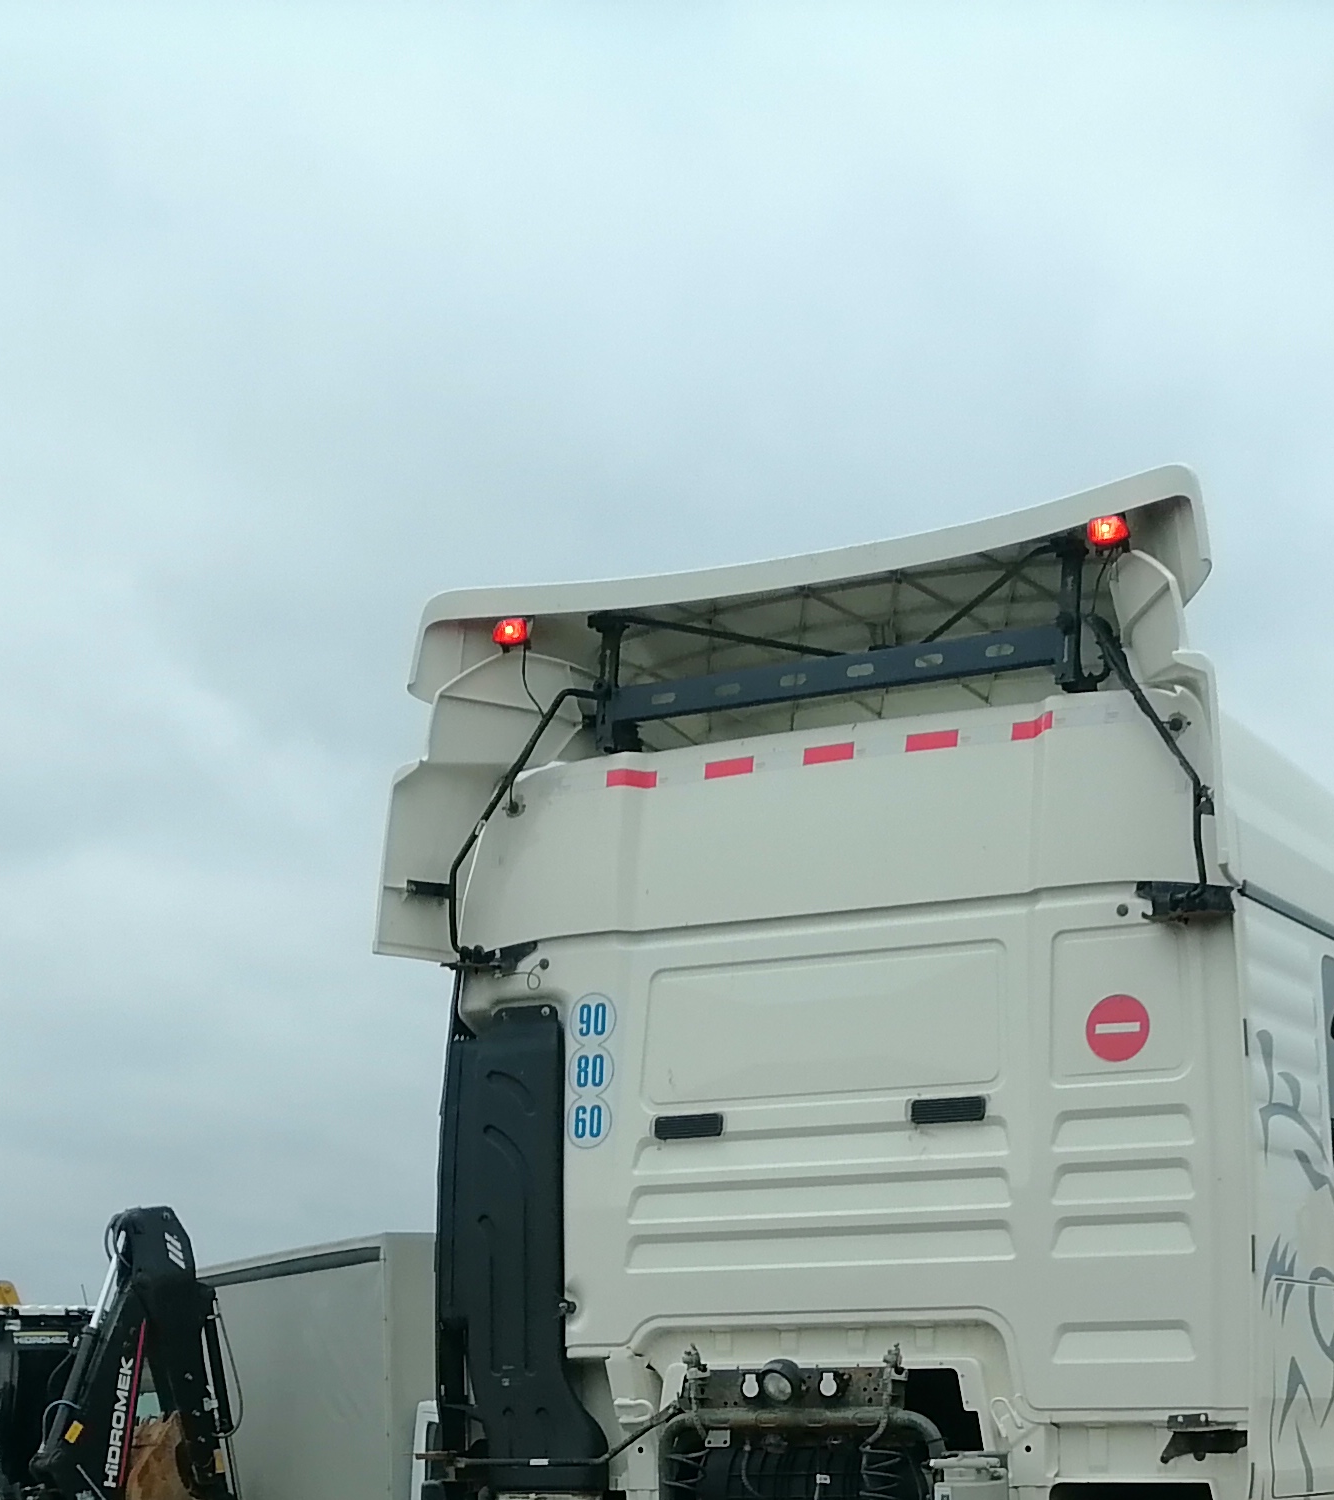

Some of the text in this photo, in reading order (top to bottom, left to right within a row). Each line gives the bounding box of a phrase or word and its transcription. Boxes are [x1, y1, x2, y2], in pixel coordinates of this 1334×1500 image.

[578, 1003, 607, 1036] 90
[576, 1054, 605, 1087] 80
[574, 1105, 602, 1138] 60
